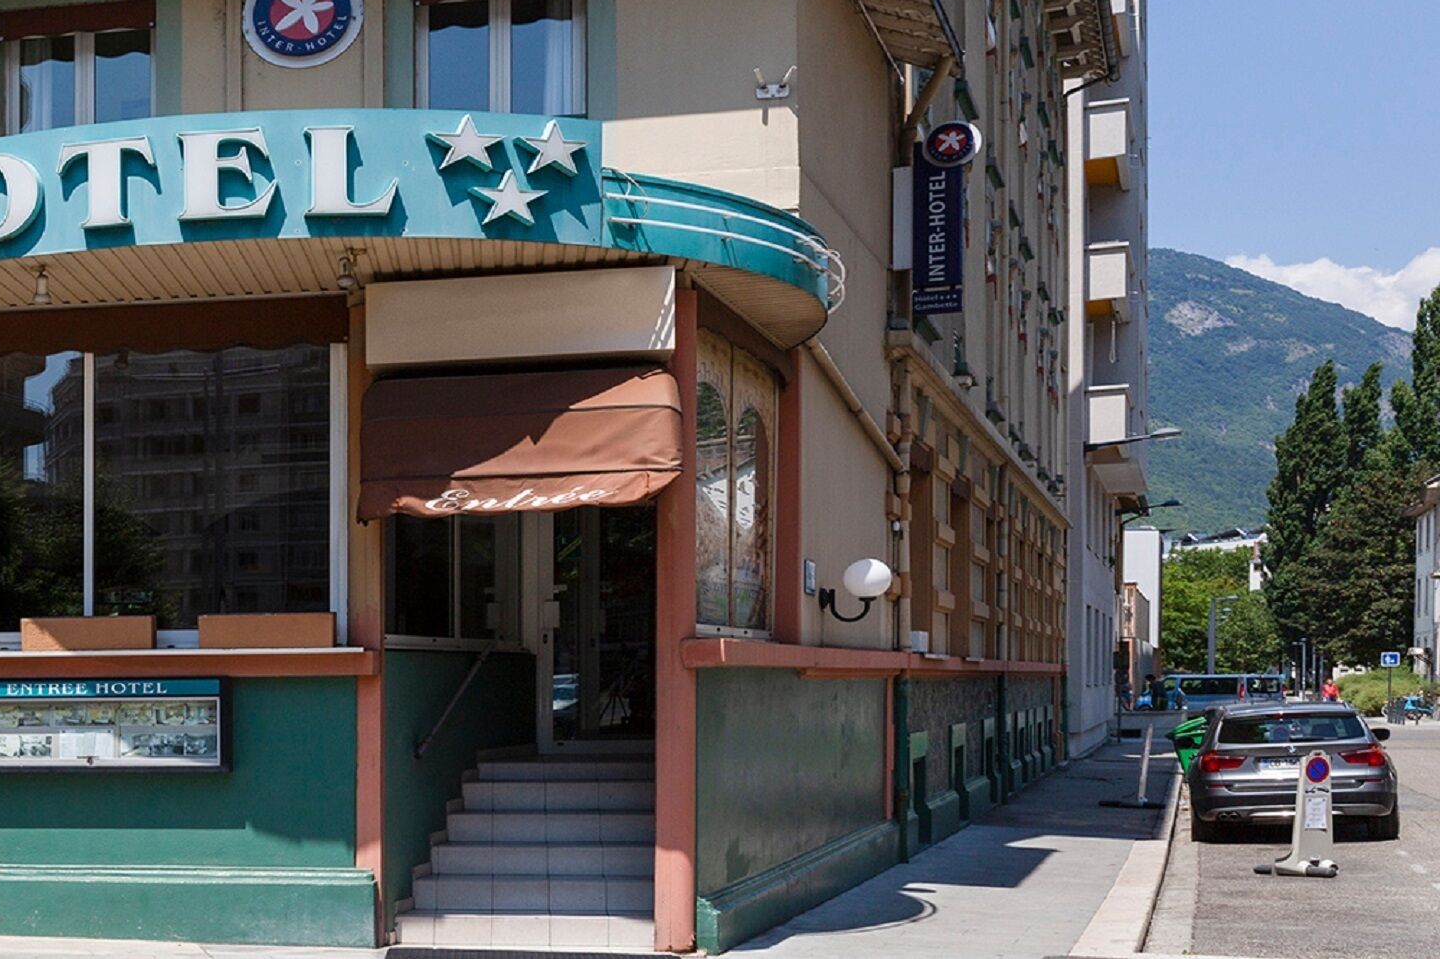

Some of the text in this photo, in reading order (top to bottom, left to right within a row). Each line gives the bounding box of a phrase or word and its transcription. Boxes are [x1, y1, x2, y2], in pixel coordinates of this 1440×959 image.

[928, 170, 946, 282] INTER-HOTEL
[424, 485, 617, 512] Entrée
[6, 682, 168, 696] ENTREE HOTEL
